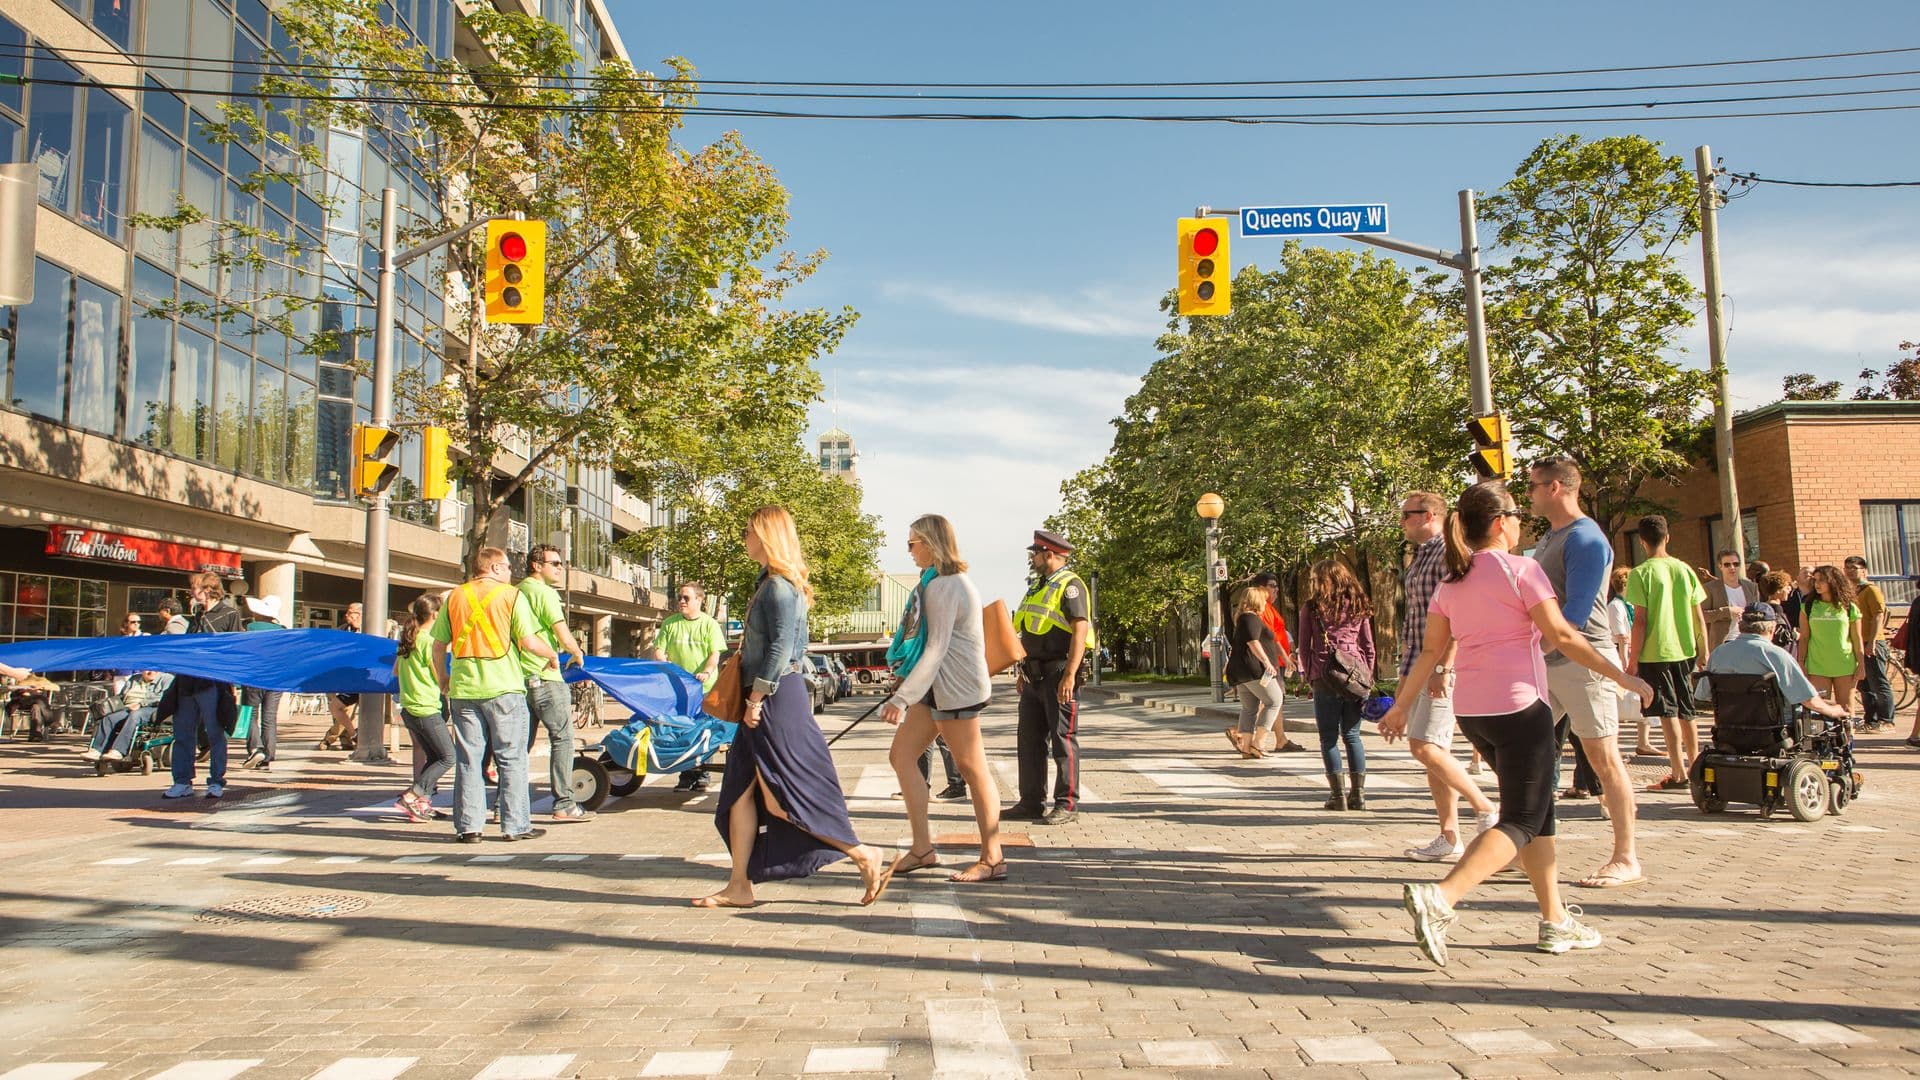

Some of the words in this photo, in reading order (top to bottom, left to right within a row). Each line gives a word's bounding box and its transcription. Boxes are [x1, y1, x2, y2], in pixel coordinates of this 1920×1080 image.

[1246, 209, 1312, 231] Queens
[1317, 207, 1361, 231] Quay
[1367, 206, 1382, 226] W
[65, 529, 91, 556] Tim
[92, 532, 137, 562] Hortons
